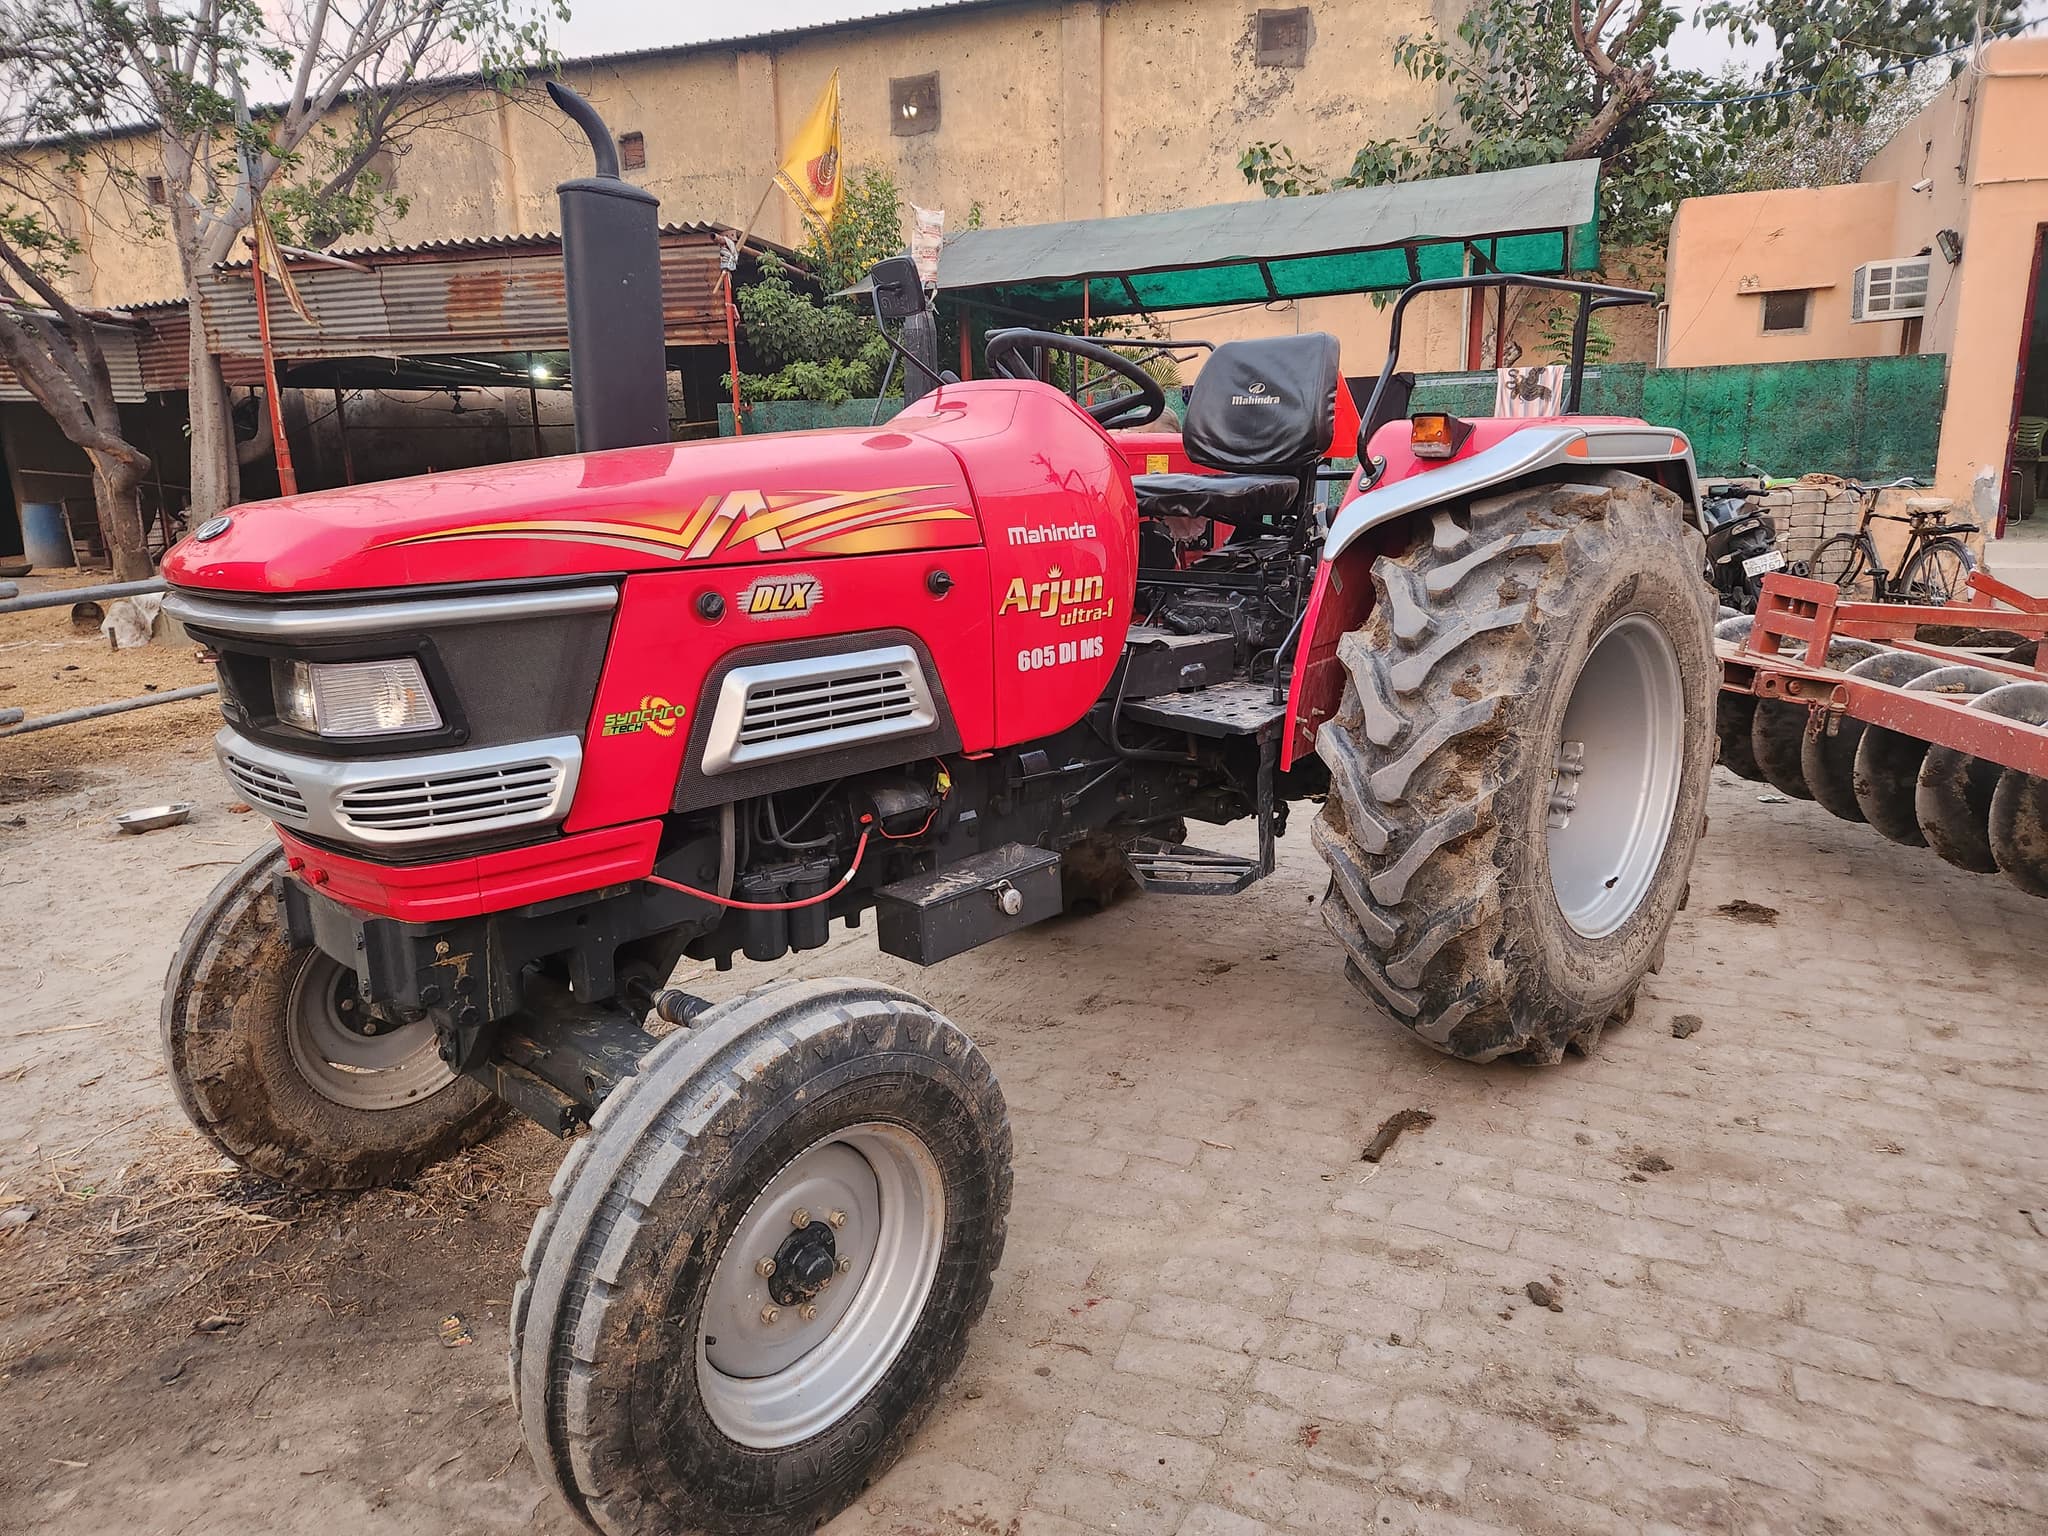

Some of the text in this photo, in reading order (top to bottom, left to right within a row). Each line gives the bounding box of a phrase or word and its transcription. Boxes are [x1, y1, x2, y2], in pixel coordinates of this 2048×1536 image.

[1232, 395, 1280, 406] Mahindra
[1007, 522, 1096, 545] Mahindra
[748, 582, 814, 614] DLX
[998, 566, 1104, 618] Arjun
[1060, 597, 1114, 626] ultra-1
[1017, 636, 1104, 672] 605 DI MS
